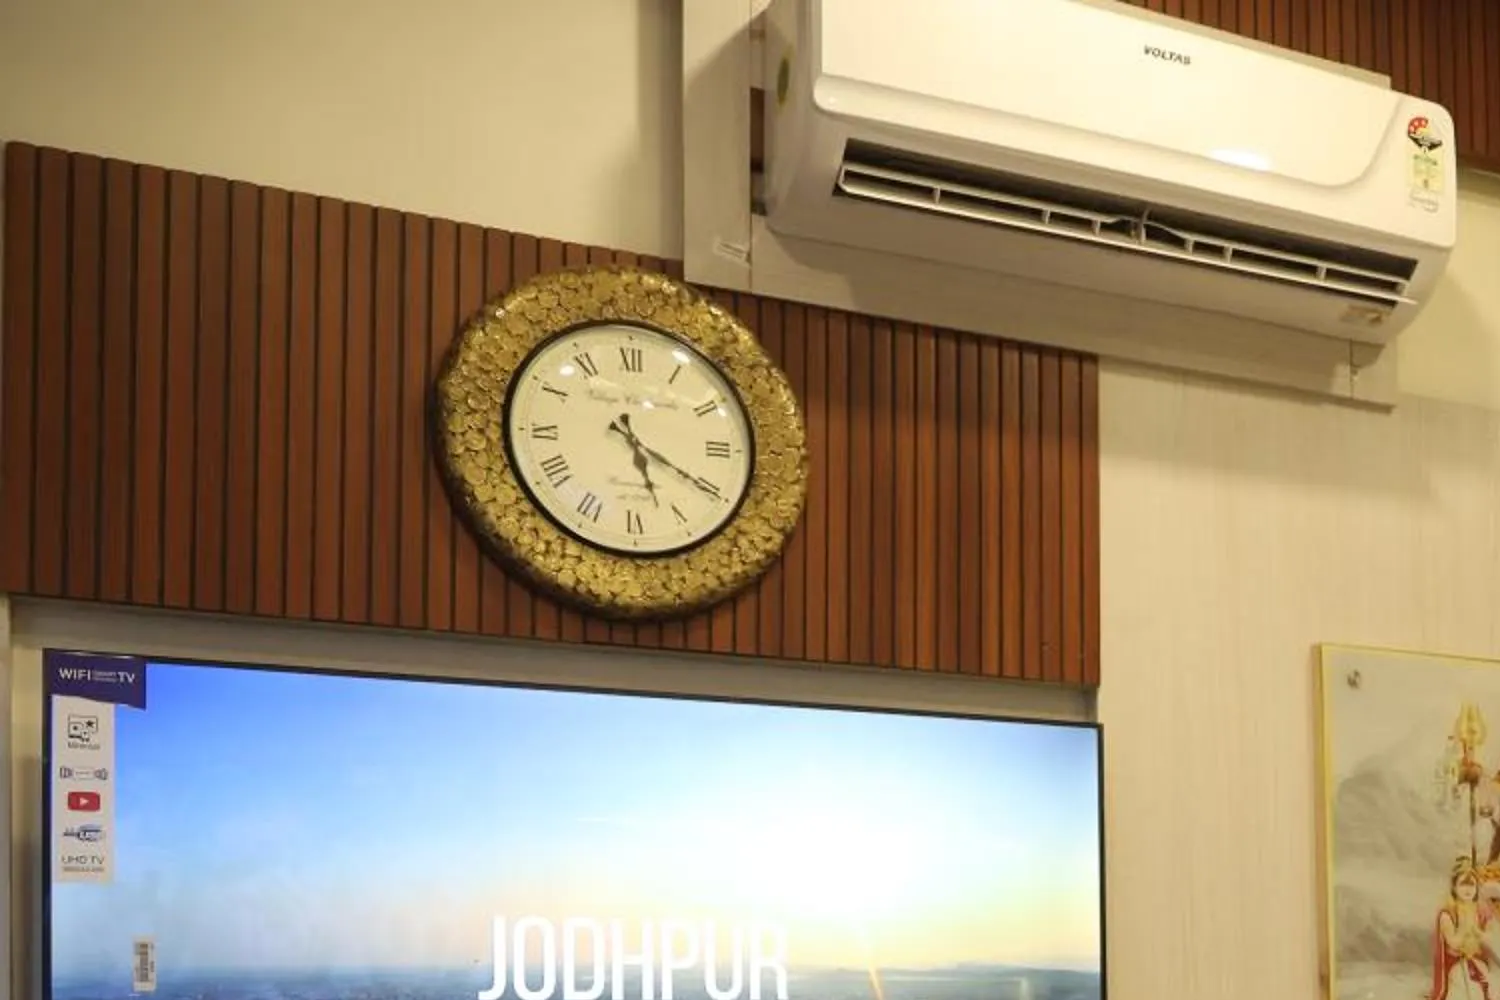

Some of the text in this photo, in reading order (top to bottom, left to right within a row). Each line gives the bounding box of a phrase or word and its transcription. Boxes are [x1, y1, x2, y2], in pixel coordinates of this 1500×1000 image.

[1144, 44, 1191, 66] VOLTAS
[619, 347, 643, 373] XII
[667, 364, 682, 385] I
[693, 399, 718, 418] II
[705, 441, 731, 458] III
[540, 454, 571, 489] VIII
[576, 491, 603, 523] VII
[626, 509, 644, 535] VI
[59, 667, 92, 682] WIFI
[117, 671, 136, 684] TV
[91, 855, 105, 865] TV
